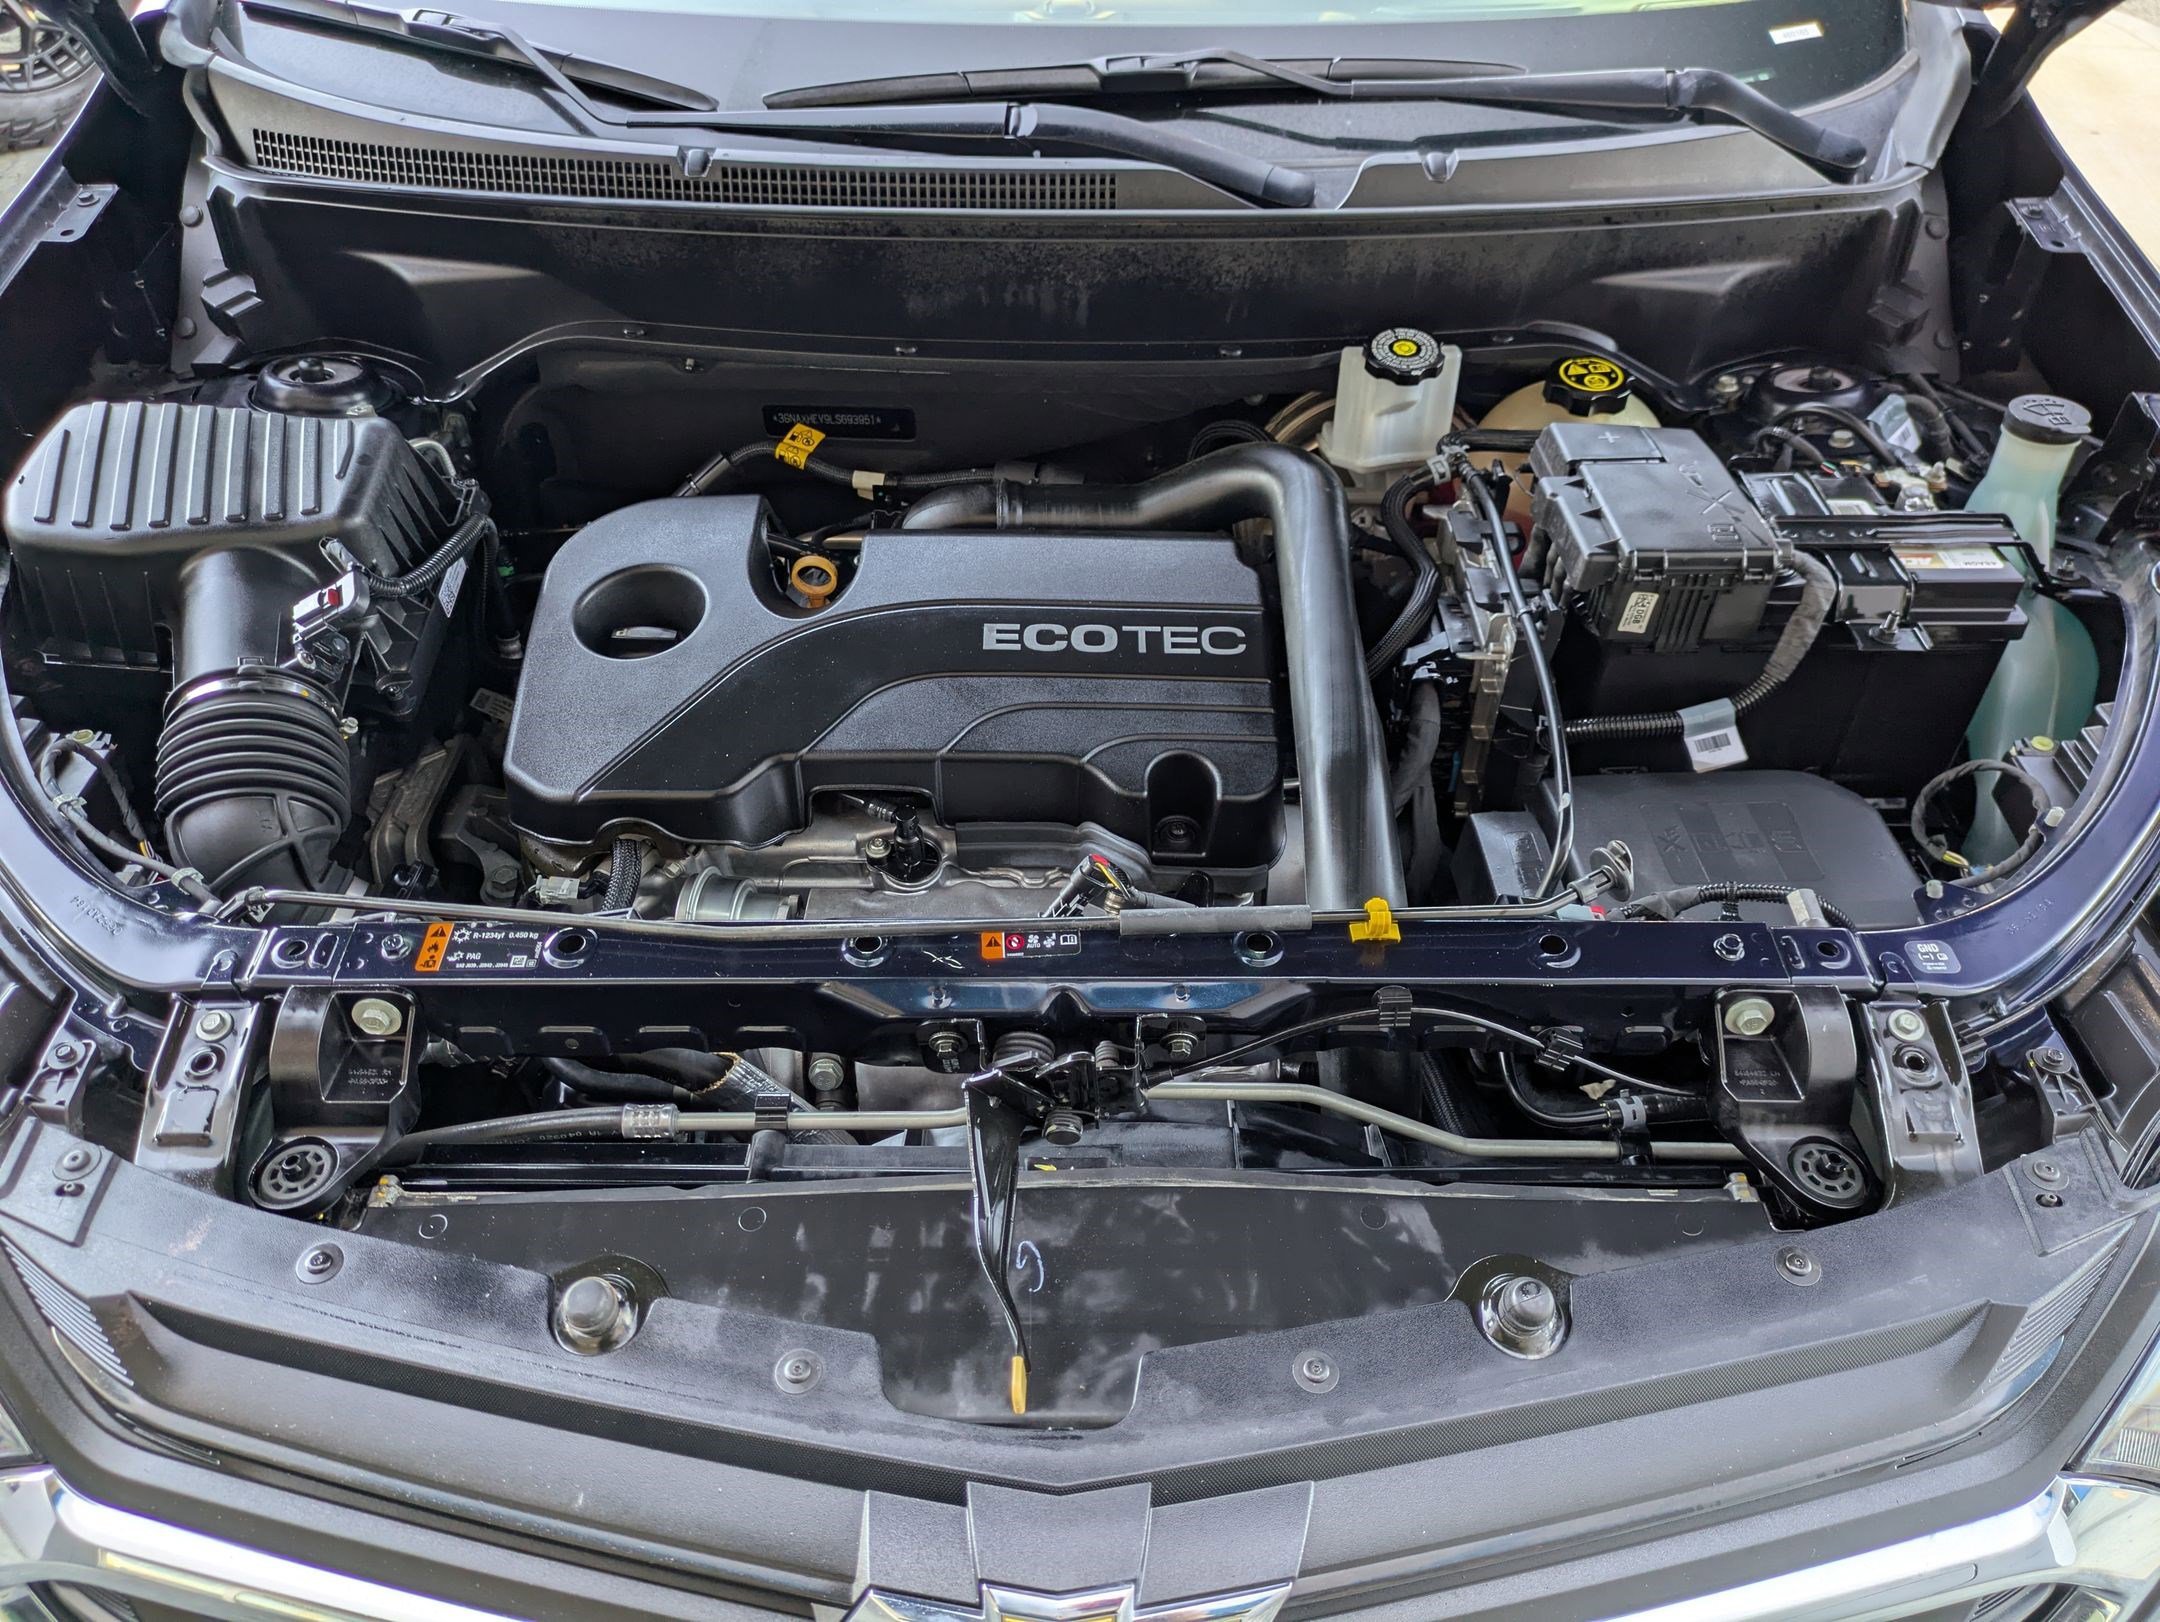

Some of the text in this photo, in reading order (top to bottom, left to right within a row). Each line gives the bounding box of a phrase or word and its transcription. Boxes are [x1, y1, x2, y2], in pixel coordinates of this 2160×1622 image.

[982, 623, 1247, 655] ECOTEC
[473, 931, 539, 940] R-1234yf 0.450 kg
[1916, 943, 1940, 953] GND
[465, 952, 482, 960] PAG
